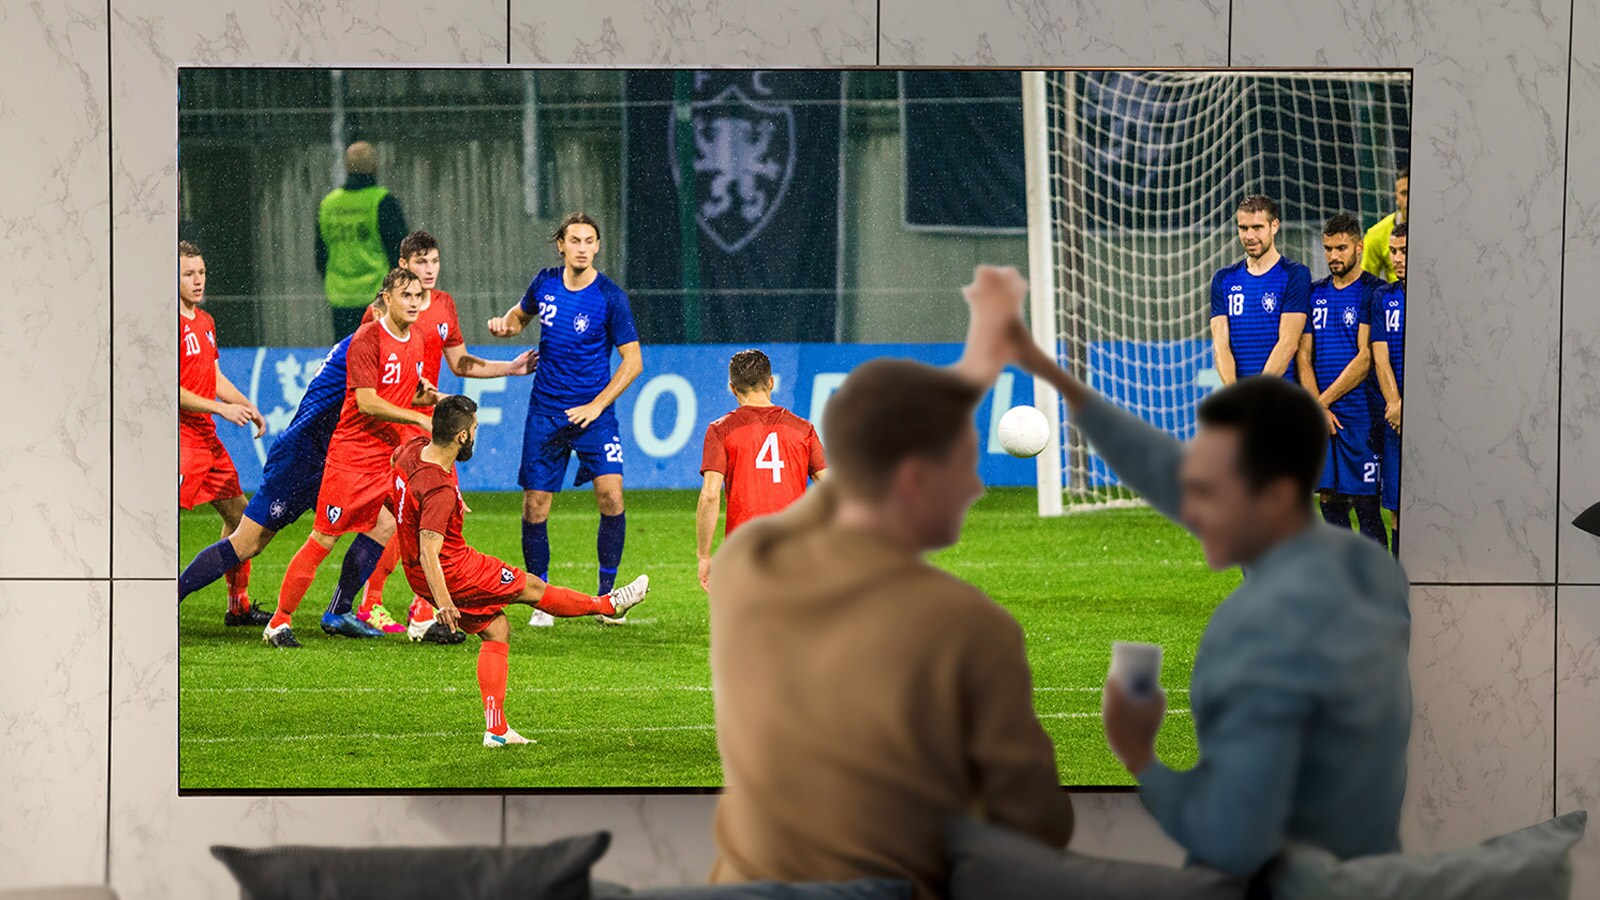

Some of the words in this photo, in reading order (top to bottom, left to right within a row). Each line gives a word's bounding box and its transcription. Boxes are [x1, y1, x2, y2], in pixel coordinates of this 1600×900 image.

[539, 302, 557, 327] 22
[1228, 293, 1245, 316] 18
[1312, 307, 1328, 330] 21
[1385, 309, 1400, 332] 14
[184, 332, 201, 356] 10
[381, 361, 401, 384] 21
[604, 443, 624, 463] 22
[755, 431, 785, 483] 4
